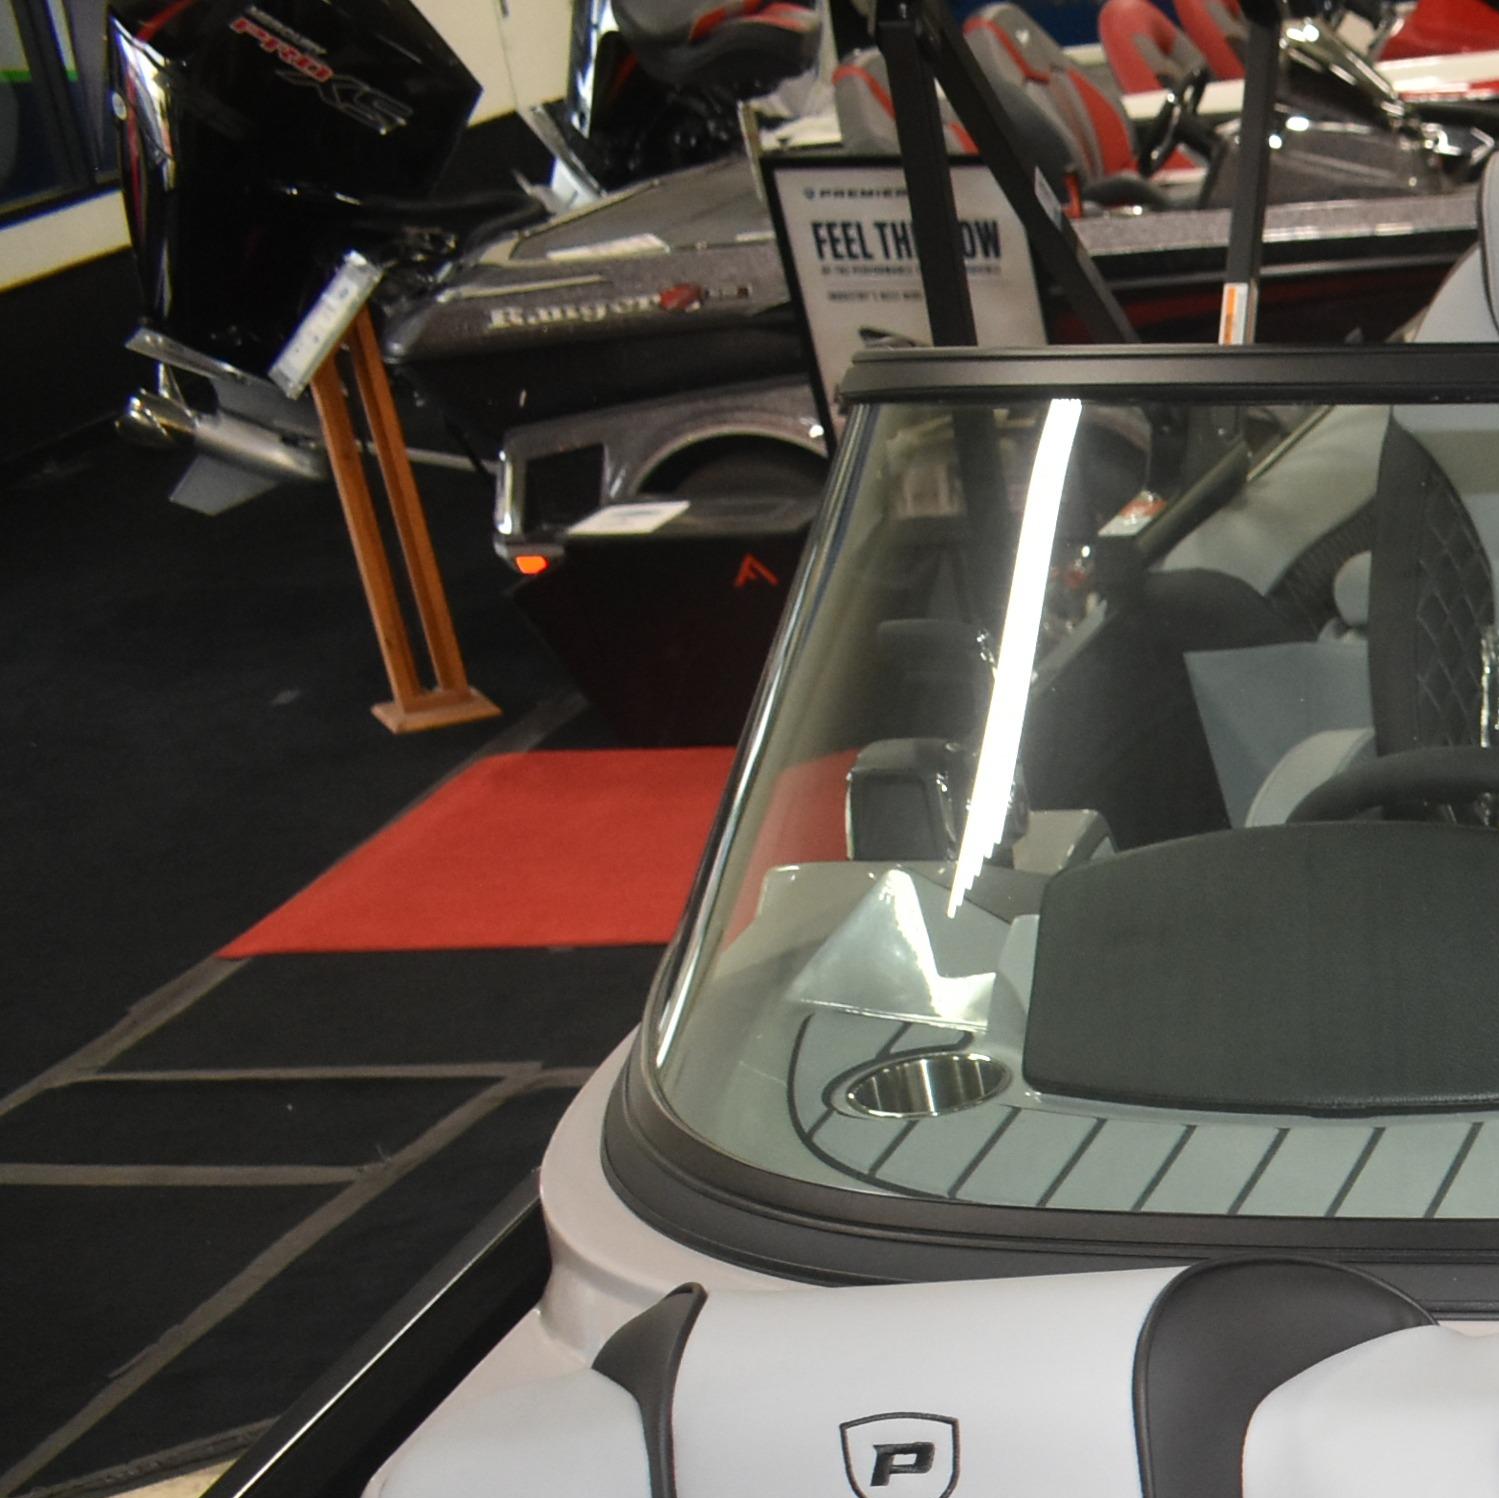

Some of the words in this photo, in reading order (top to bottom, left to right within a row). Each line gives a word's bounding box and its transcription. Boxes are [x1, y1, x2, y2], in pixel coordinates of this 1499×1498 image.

[811, 220, 874, 261] FEEL
[873, 220, 914, 261] TH
[869, 1441, 936, 1488] P
